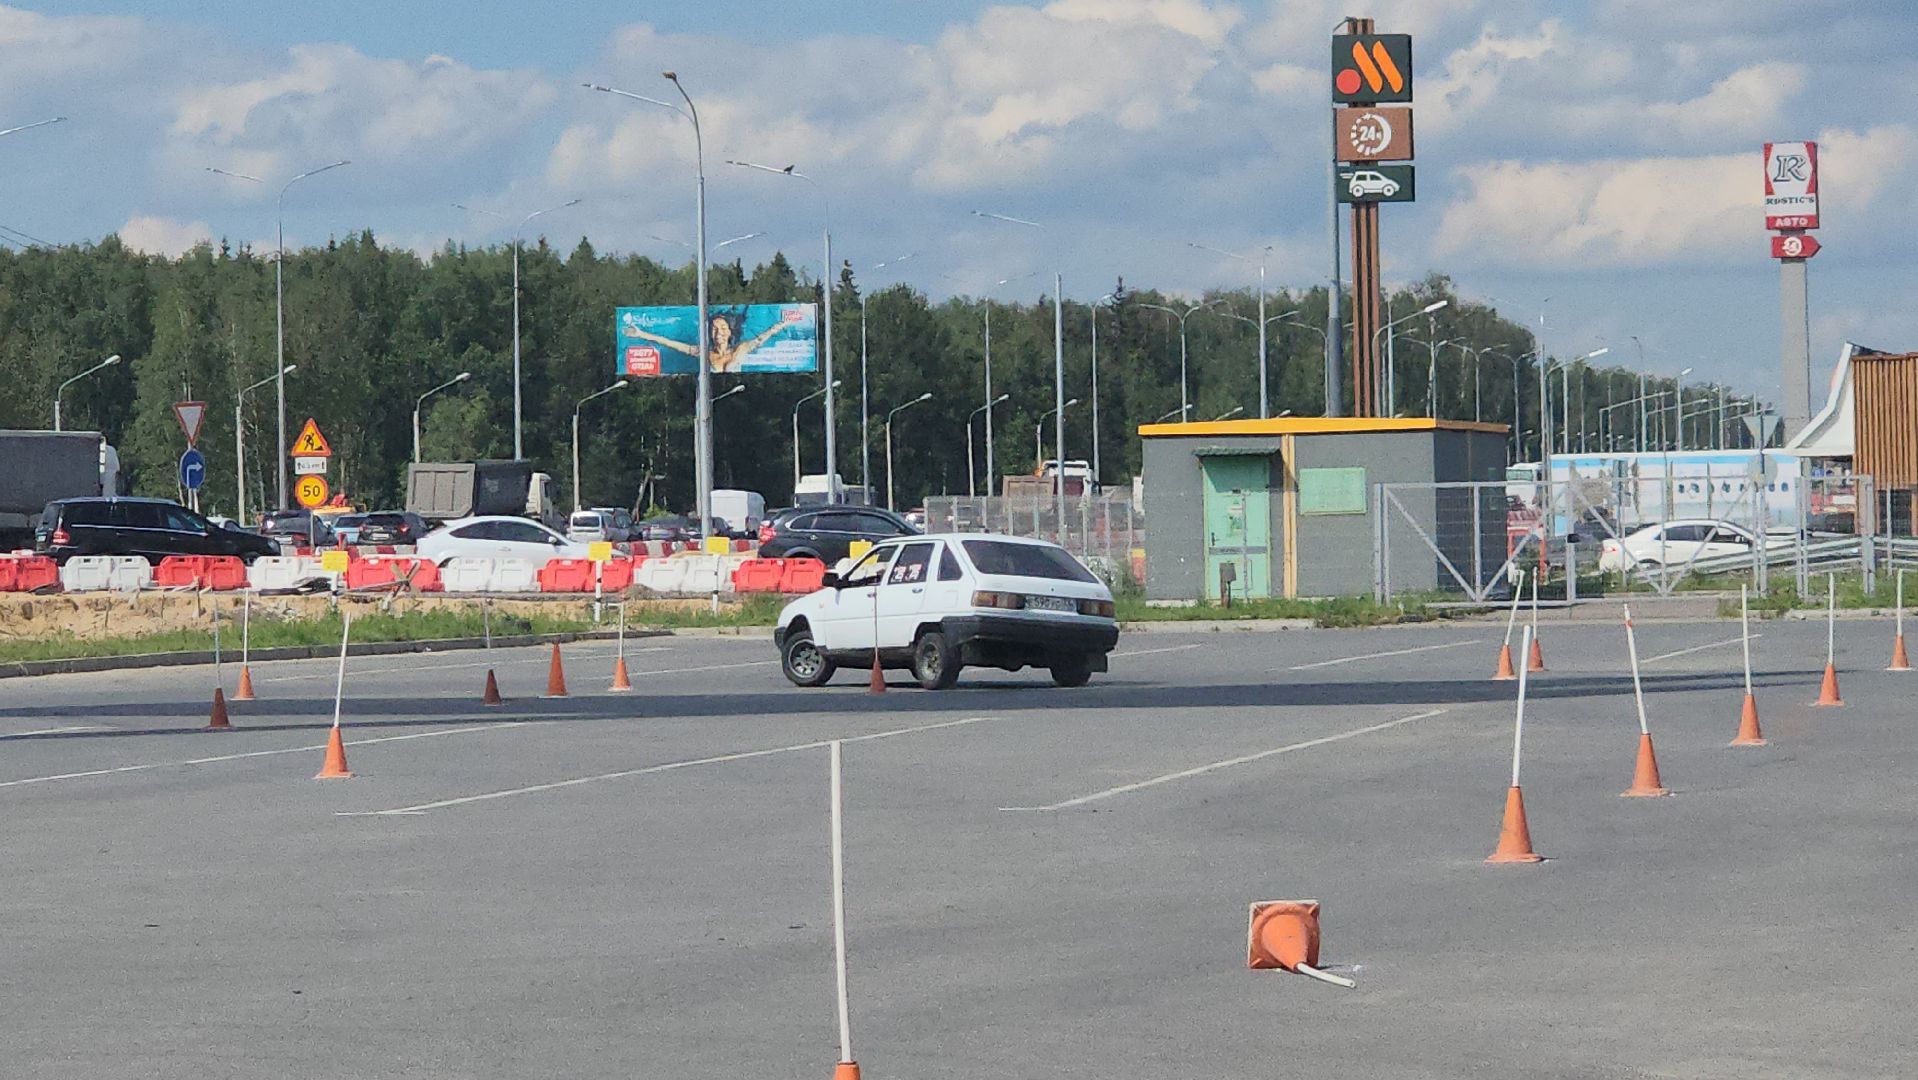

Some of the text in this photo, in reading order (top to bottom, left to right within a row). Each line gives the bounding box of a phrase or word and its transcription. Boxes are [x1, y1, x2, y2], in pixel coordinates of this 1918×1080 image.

[1360, 126, 1376, 141] 24
[1773, 155, 1807, 182] R
[303, 485, 321, 497] 50
